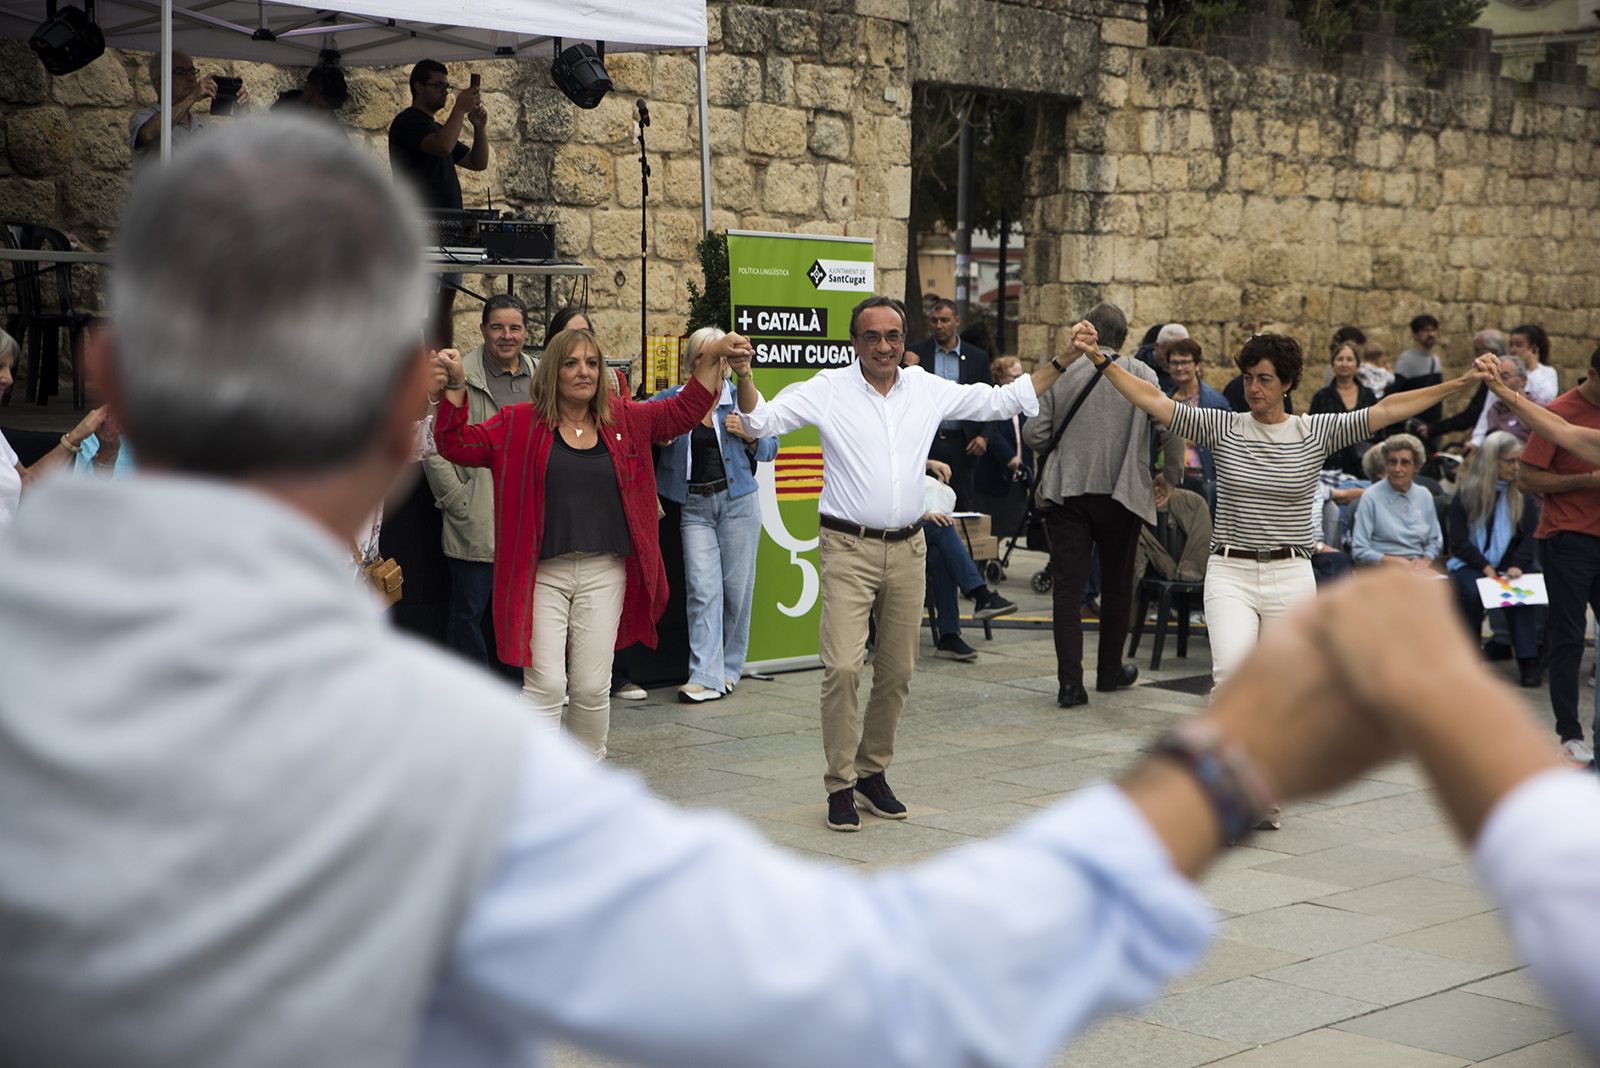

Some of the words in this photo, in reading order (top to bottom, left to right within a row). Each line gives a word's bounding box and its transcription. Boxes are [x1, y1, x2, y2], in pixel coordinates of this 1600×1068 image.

[757, 308, 821, 332] CATALÀ
[756, 343, 802, 363] SANT
[804, 344, 855, 364] CUGAT
